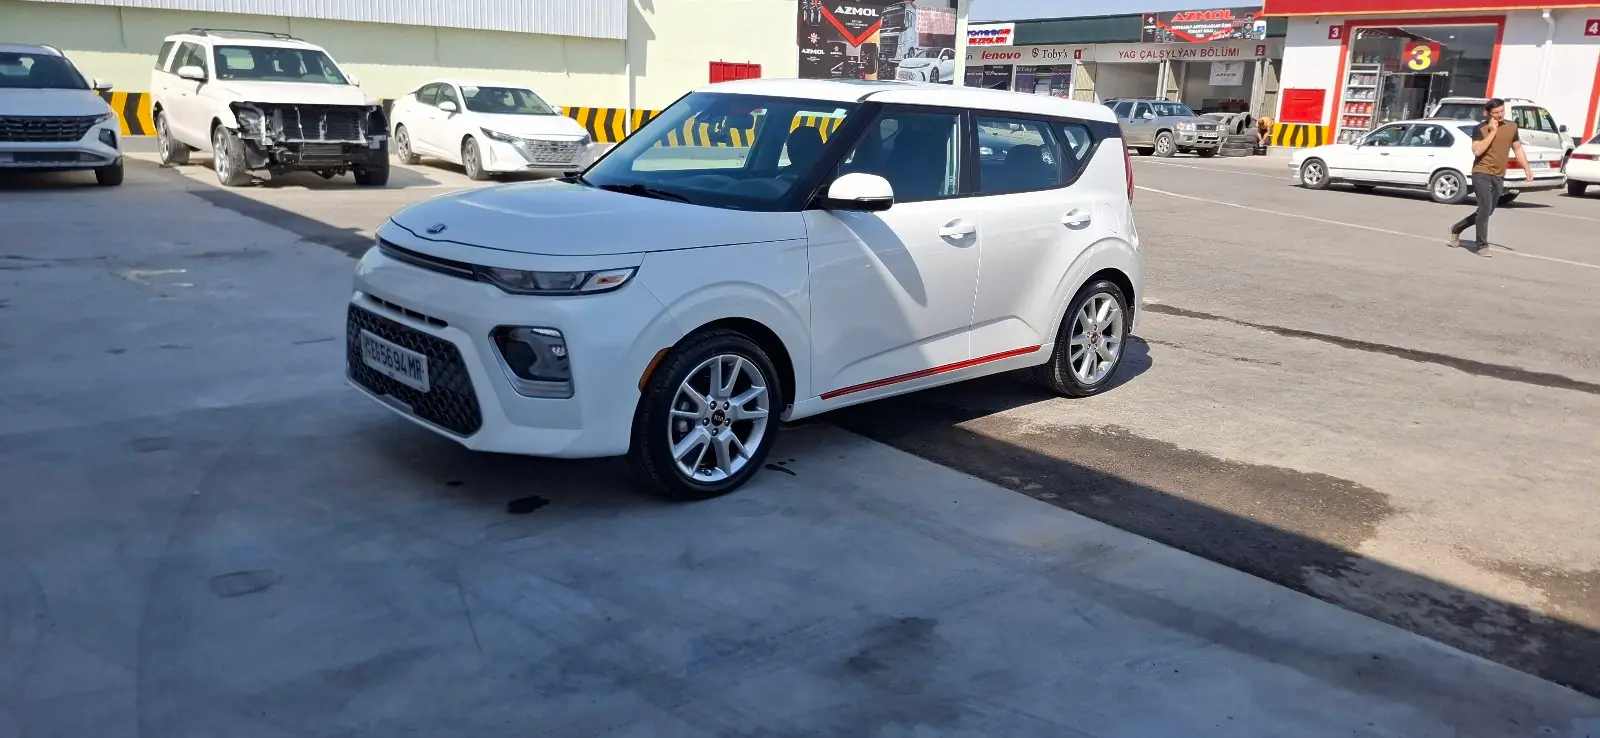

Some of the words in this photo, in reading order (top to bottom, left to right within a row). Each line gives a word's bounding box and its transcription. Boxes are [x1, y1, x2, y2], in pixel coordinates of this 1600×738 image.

[834, 6, 879, 17] AZMOL
[1171, 10, 1235, 22] AZMOL
[1332, 28, 1339, 38] 3
[1588, 22, 1598, 34] 4
[1041, 48, 1068, 60] Toby's
[1408, 45, 1432, 70] 3
